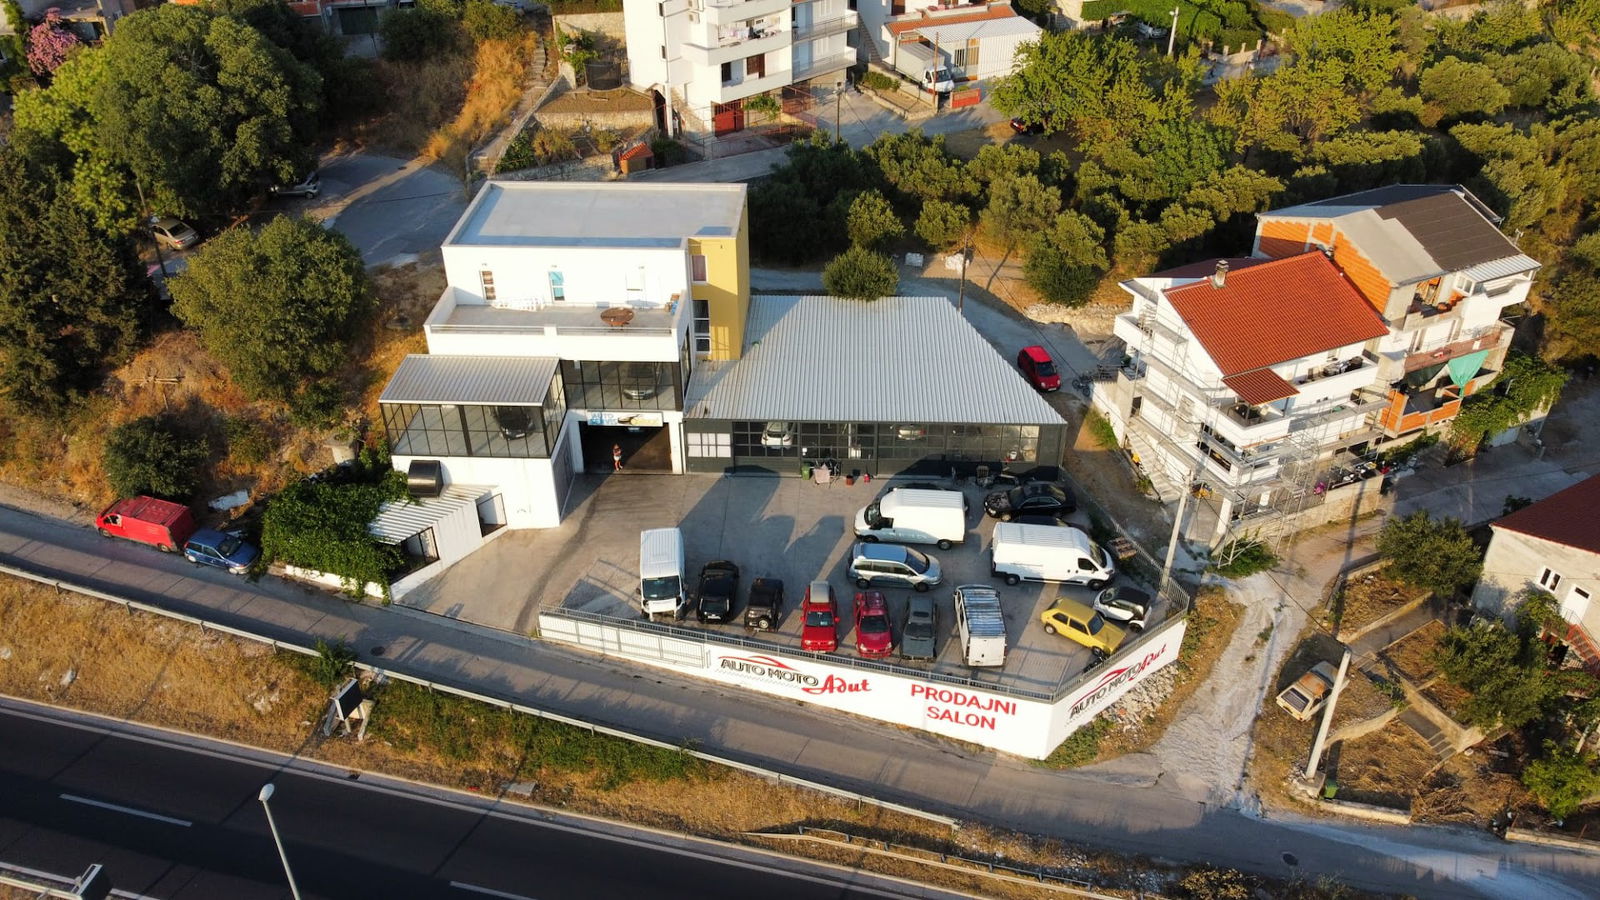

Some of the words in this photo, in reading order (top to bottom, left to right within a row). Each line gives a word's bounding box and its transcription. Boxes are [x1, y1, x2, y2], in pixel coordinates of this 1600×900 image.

[721, 658, 765, 676] AUTO
[767, 667, 819, 687] MOTO
[801, 674, 872, 695] Adut
[1069, 688, 1107, 719] AUTO
[1108, 662, 1141, 691] MOTO
[1128, 644, 1166, 682] Adut
[911, 683, 1017, 716] PRODAJNI
[926, 705, 996, 730] SALON
